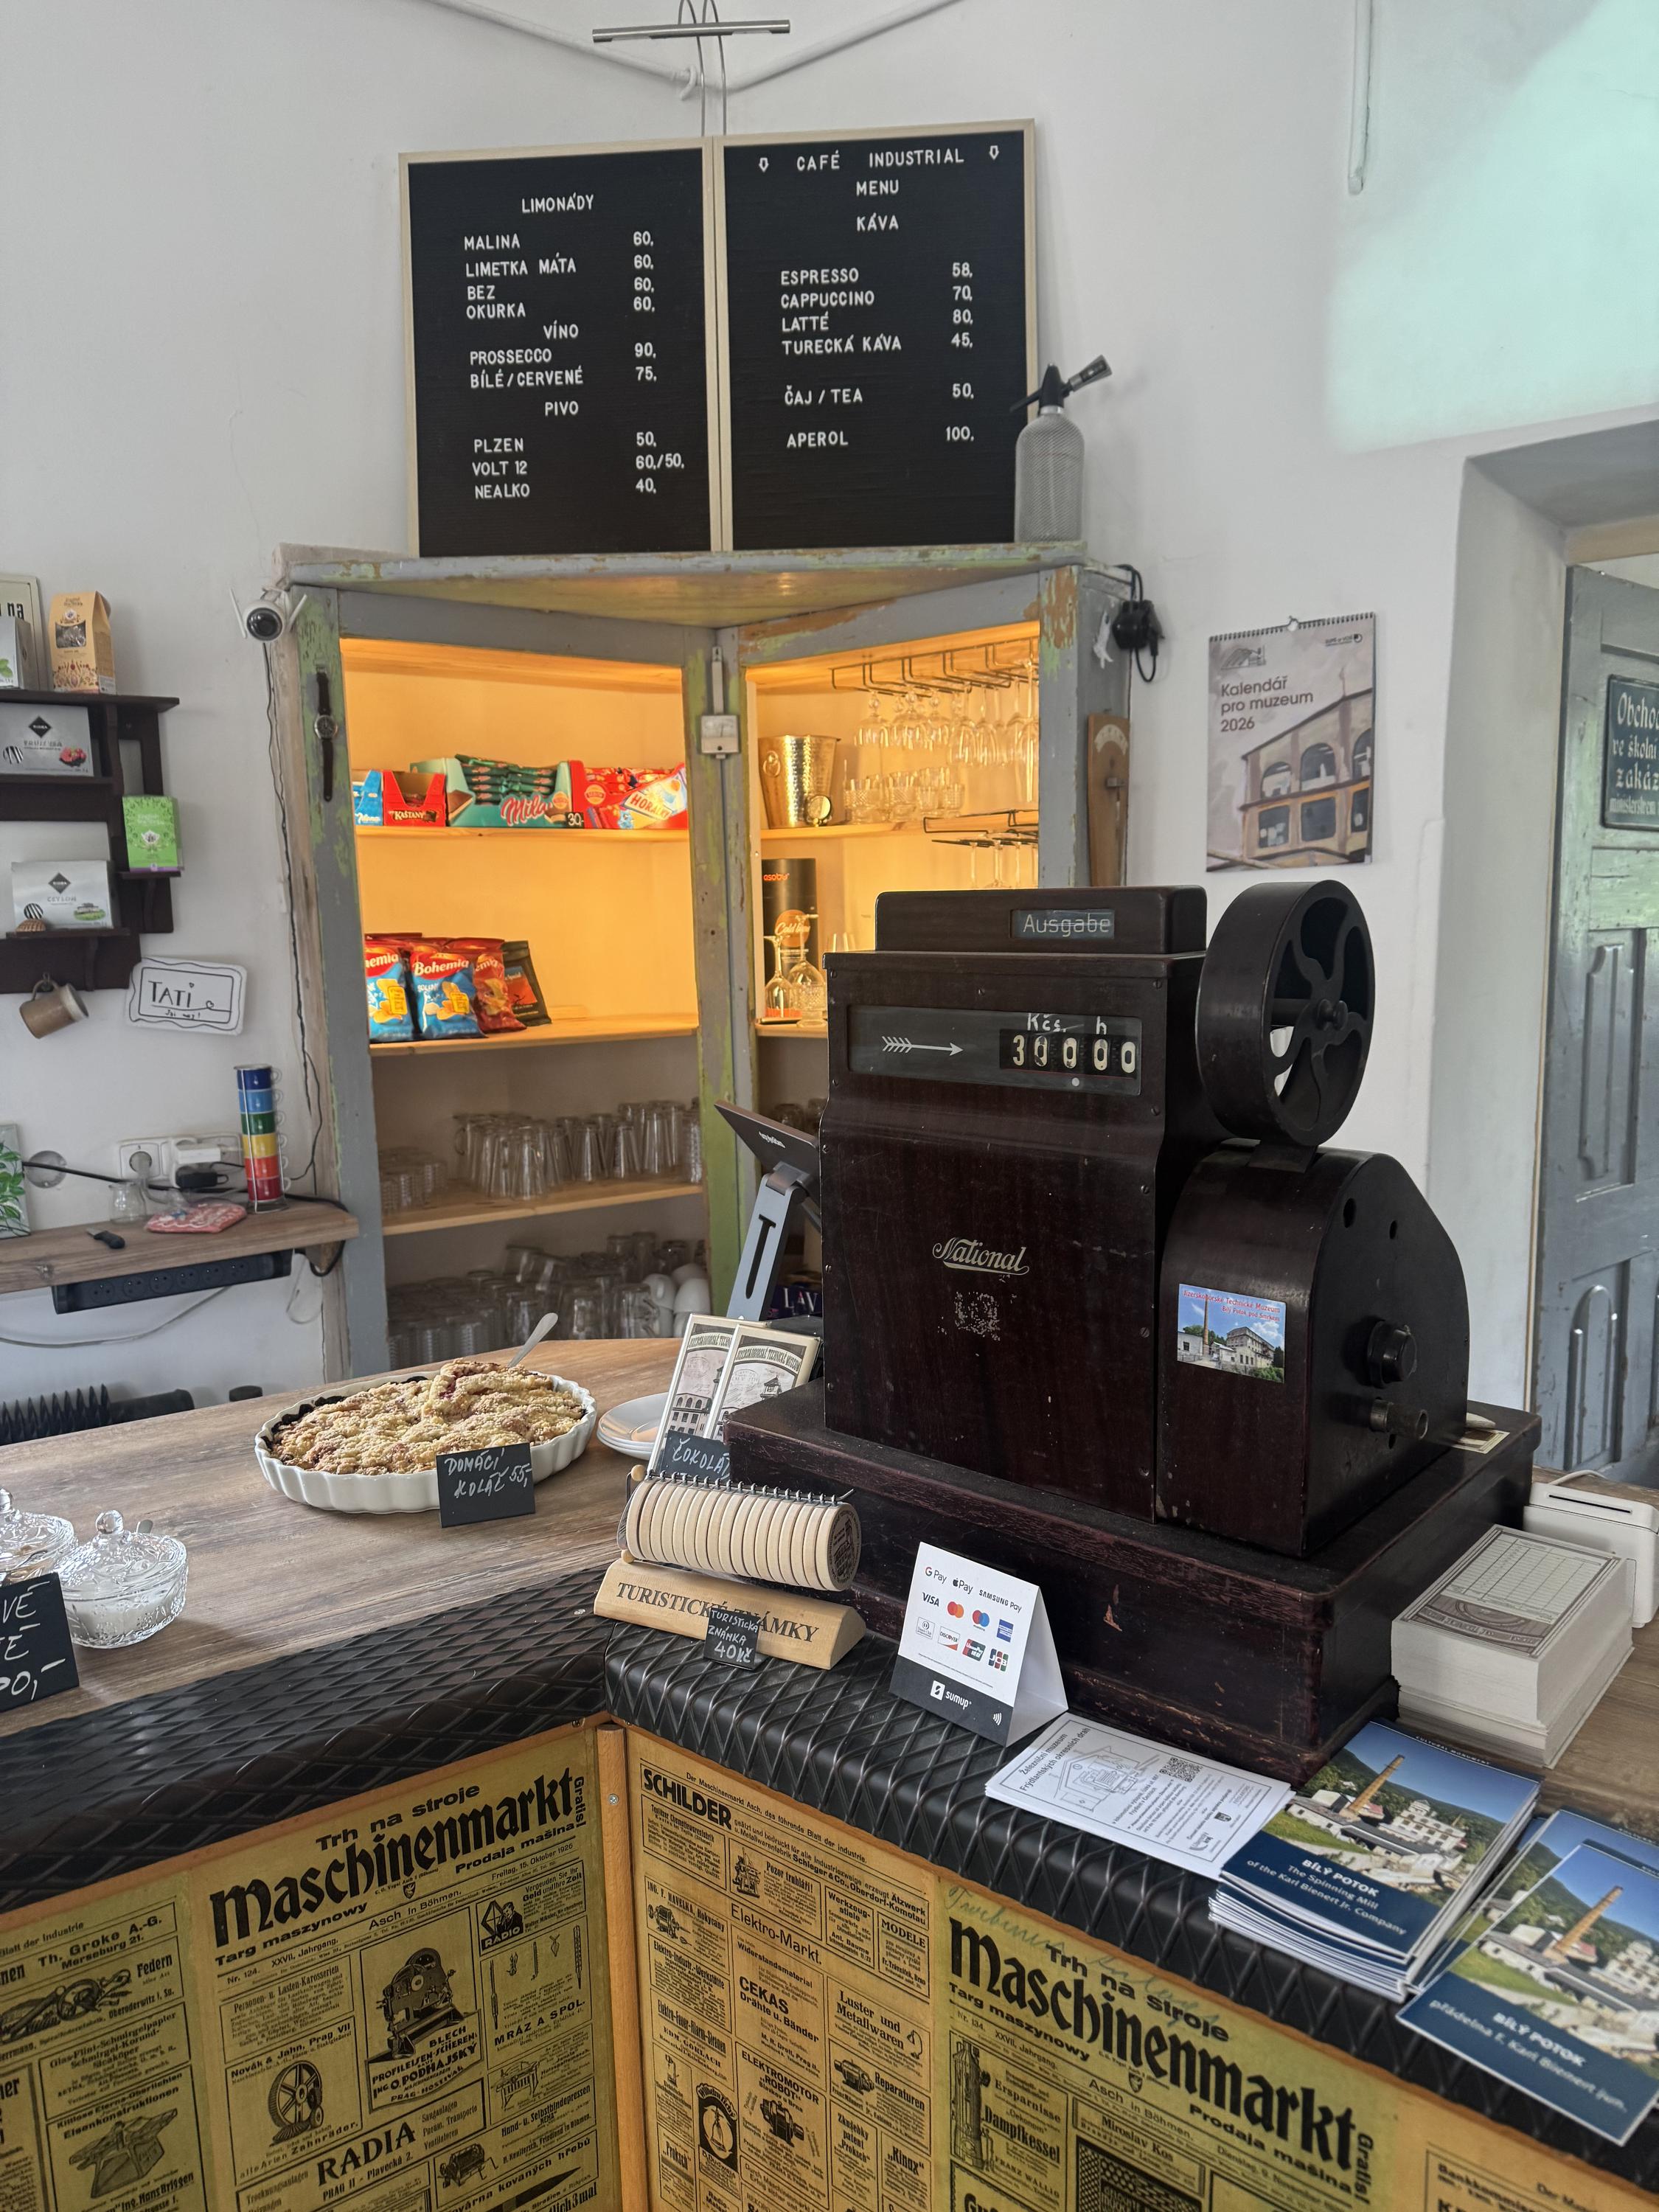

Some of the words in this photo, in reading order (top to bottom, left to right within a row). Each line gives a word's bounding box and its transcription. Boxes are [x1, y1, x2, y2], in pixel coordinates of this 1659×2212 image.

[796, 150, 840, 171] CAFÉ
[869, 148, 964, 168] INDUSTRIAL
[856, 179, 899, 196] MENU
[521, 192, 594, 213] LIMONÁDY
[857, 212, 899, 232] KÁVA
[464, 233, 521, 251] MALINA
[465, 260, 528, 277] LIMETKA
[538, 252, 577, 274] MÁTA
[781, 267, 859, 285] ESPRESSO
[467, 285, 495, 301] BEZ
[781, 290, 874, 309] CAPPUCCINO
[466, 302, 526, 319] OKURKA
[782, 310, 829, 333] LATTÉ
[543, 320, 579, 339] VÍNO
[782, 334, 854, 355] TURECKÁ
[863, 333, 902, 352] KÁVA
[470, 348, 552, 366] PROSSECCO
[545, 400, 579, 416] PIVO
[785, 385, 813, 406] ČAJ
[831, 389, 863, 405] TEA
[474, 437, 524, 453] PLZEN
[787, 431, 849, 448] APEROL
[472, 462, 509, 476] VOLT
[515, 460, 528, 475] 12
[475, 483, 530, 499] NEALKO
[1221, 675, 1288, 696] Kalendář
[1221, 701, 1245, 716] pro
[1249, 692, 1313, 711] muzeum
[1221, 718, 1255, 733] 2026
[394, 810, 424, 821] KAŠTANY
[630, 792, 669, 819] HORALKY
[1023, 913, 1110, 938] Ausgabe
[414, 958, 470, 976] Bohemia
[1096, 1015, 1107, 1035] h
[932, 1237, 1030, 1276] National
[444, 1447, 505, 1475] DOMÁCÍ
[453, 1466, 509, 1498] KOLÁČ
[922, 1592, 940, 1607] VISA
[925, 1566, 933, 1577] G
[933, 1569, 947, 1585] Pay
[958, 1579, 973, 1595] Pay
[978, 1589, 1009, 1606] SAMSUNG
[1009, 1601, 1023, 1613] Pay
[616, 1582, 728, 1618] TURISTICK
[734, 1608, 819, 1643] ÁMKY
[939, 1631, 959, 1643] DISCOVER
[991, 1654, 1007, 1666] JCB
[1045, 1733, 1068, 1753] muzeum
[574, 1775, 587, 1828] Gratis!
[643, 1767, 732, 1832] SCHILDER
[316, 1828, 359, 1851] Trh
[370, 1812, 403, 1833] na
[411, 1784, 480, 1818] stroje
[209, 1767, 574, 1949] Maschinenmarkt
[1288, 1865, 1307, 1878] The
[1307, 1874, 1355, 1901] Spinning
[1356, 1896, 1380, 1910] Mill
[1301, 1859, 1333, 1876] BÍLÝ
[1333, 1872, 1380, 1897] POTOK
[215, 1945, 257, 1966] Targ
[262, 1902, 368, 1950] maszynowy
[455, 1845, 515, 1874] Prodaja
[521, 1822, 575, 1849] mašina
[1247, 1860, 1260, 1868] of
[1259, 1864, 1277, 1877] the
[1278, 1872, 1300, 1886] Karl
[1300, 1882, 1340, 1905] Bienert
[1340, 1900, 1352, 1911] jr.
[1354, 1907, 1408, 1935] Company
[484, 1925, 521, 1947] RADIO
[731, 1902, 822, 1965] Elektro-Markt.
[881, 1919, 926, 1948] MODELE
[740, 1975, 789, 2014] CEKAS
[1046, 1943, 1088, 1978] Trh
[1100, 1972, 1135, 2000] na
[1147, 1994, 1230, 2042] stroje
[494, 2023, 532, 2047] MRÁZ
[536, 2016, 545, 2027] A
[549, 2000, 586, 2020] SPOL.
[740, 1990, 771, 2014] Drähte
[773, 2011, 782, 2023] u.
[783, 2016, 819, 2043] Bänder
[839, 1990, 874, 2018] Luster
[880, 2014, 900, 2034] und
[428, 2025, 466, 2048] BLECH
[836, 2002, 905, 2050] Metallwaren
[948, 1916, 1357, 2171] Maschinenmarkt
[741, 2049, 820, 2105] ELEKTROMOTOR
[949, 1981, 984, 2010] Targ
[989, 2003, 1091, 2063] maszynowy
[1189, 2103, 1267, 2152] Prodaja
[1273, 2148, 1353, 2194] mašina
[874, 2070, 925, 2112] Reparaturen
[1101, 2113, 1149, 2148] Miroslav
[1152, 2142, 1175, 2163] Kos
[316, 2121, 417, 2187] RADIA
[1354, 2132, 1374, 2205] Gratis!
